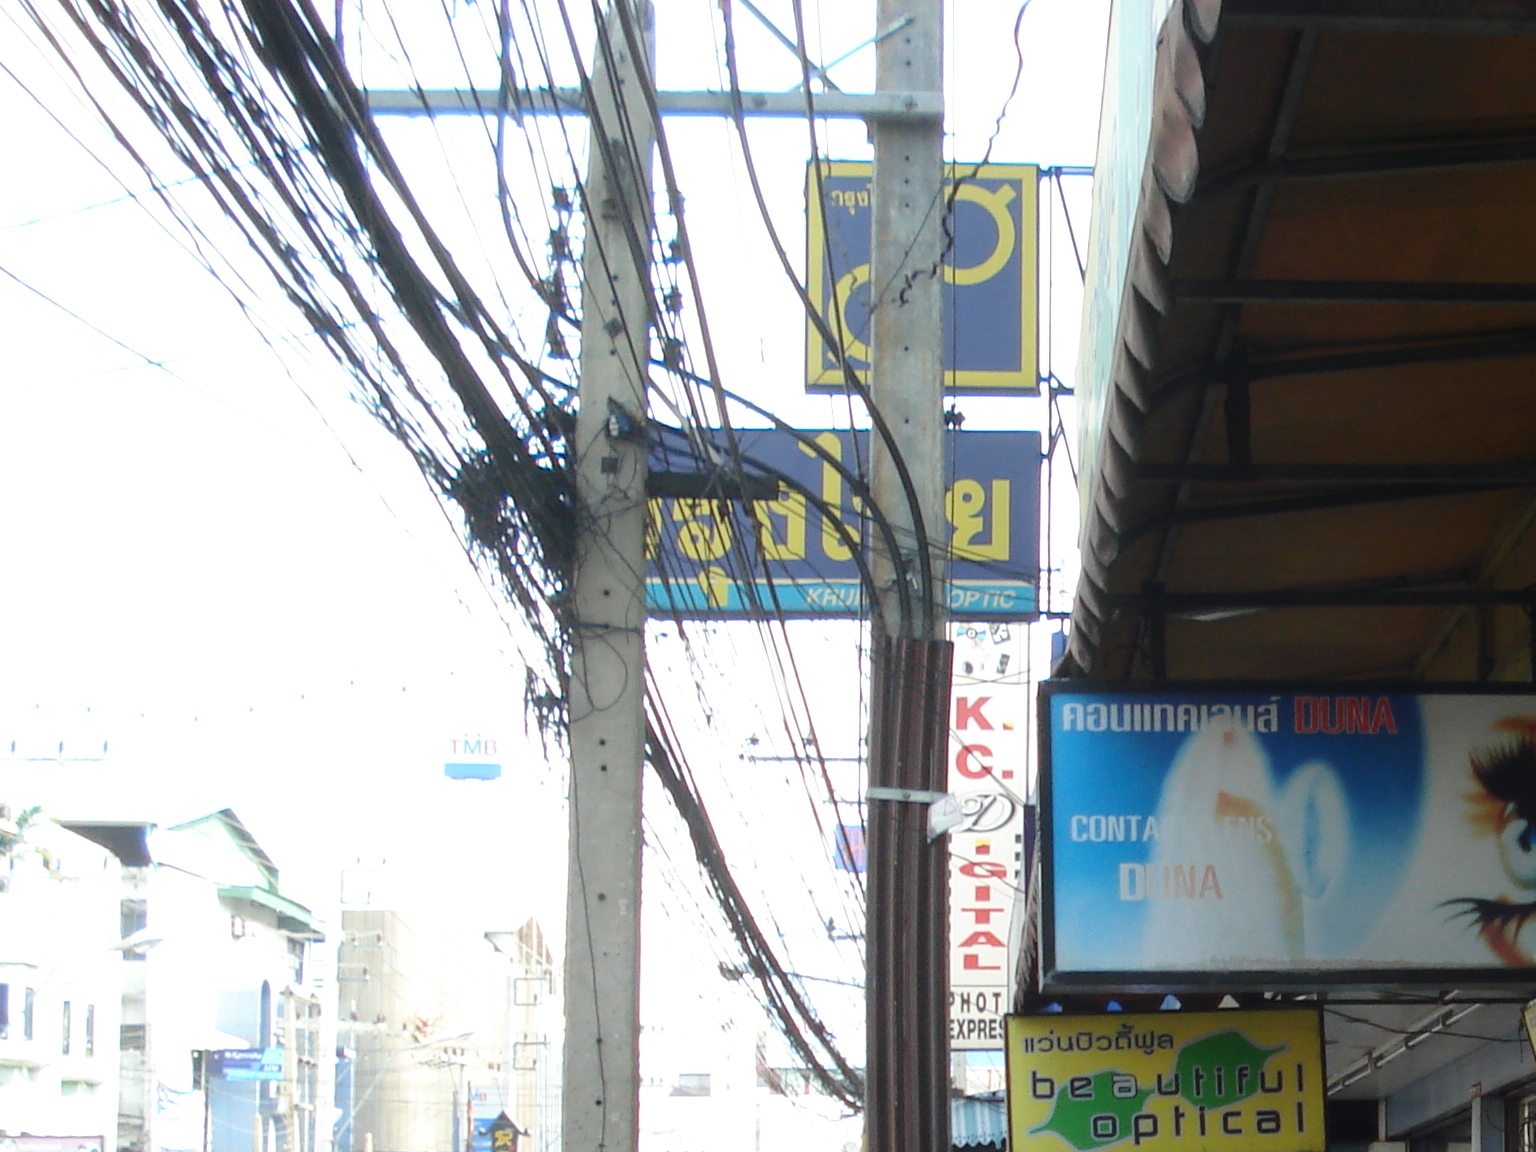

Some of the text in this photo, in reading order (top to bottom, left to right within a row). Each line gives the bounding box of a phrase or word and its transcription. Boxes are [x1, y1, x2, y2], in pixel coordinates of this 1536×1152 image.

[947, 589, 1015, 607] OPTIC
[1294, 695, 1398, 735] DUNA
[449, 735, 497, 755] TMB
[1118, 863, 1224, 902] DUNA
[1030, 1062, 1306, 1101] beautiful
[1090, 1101, 1306, 1146] optical
